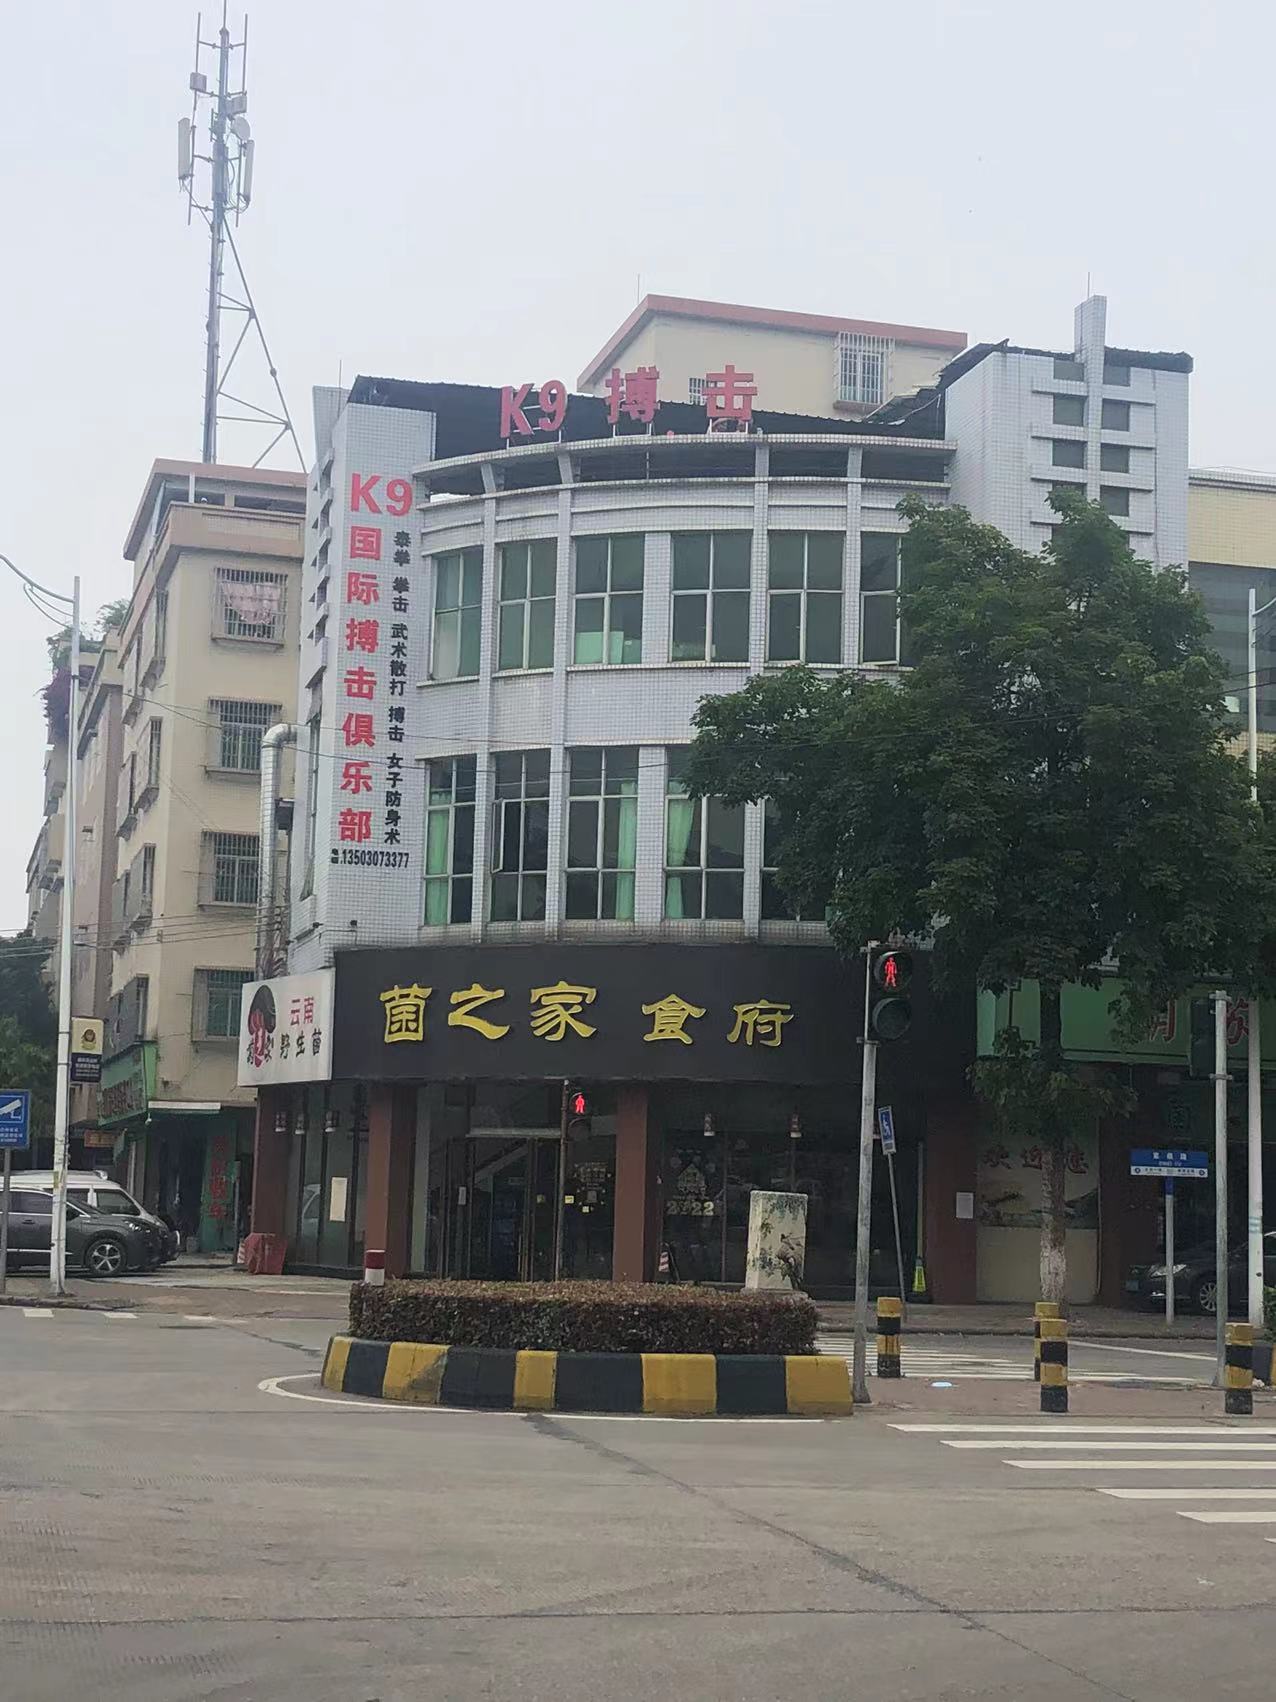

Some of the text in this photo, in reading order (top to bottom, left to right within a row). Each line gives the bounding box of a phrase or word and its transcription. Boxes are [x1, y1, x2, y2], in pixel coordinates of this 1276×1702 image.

[500, 365, 757, 438] K9 搏击
[350, 472, 413, 517] K9
[338, 525, 382, 844] 国际搏击俱乐部
[384, 752, 404, 846] 女子防身术
[289, 995, 315, 1027] 云南
[641, 993, 795, 1047] 食府
